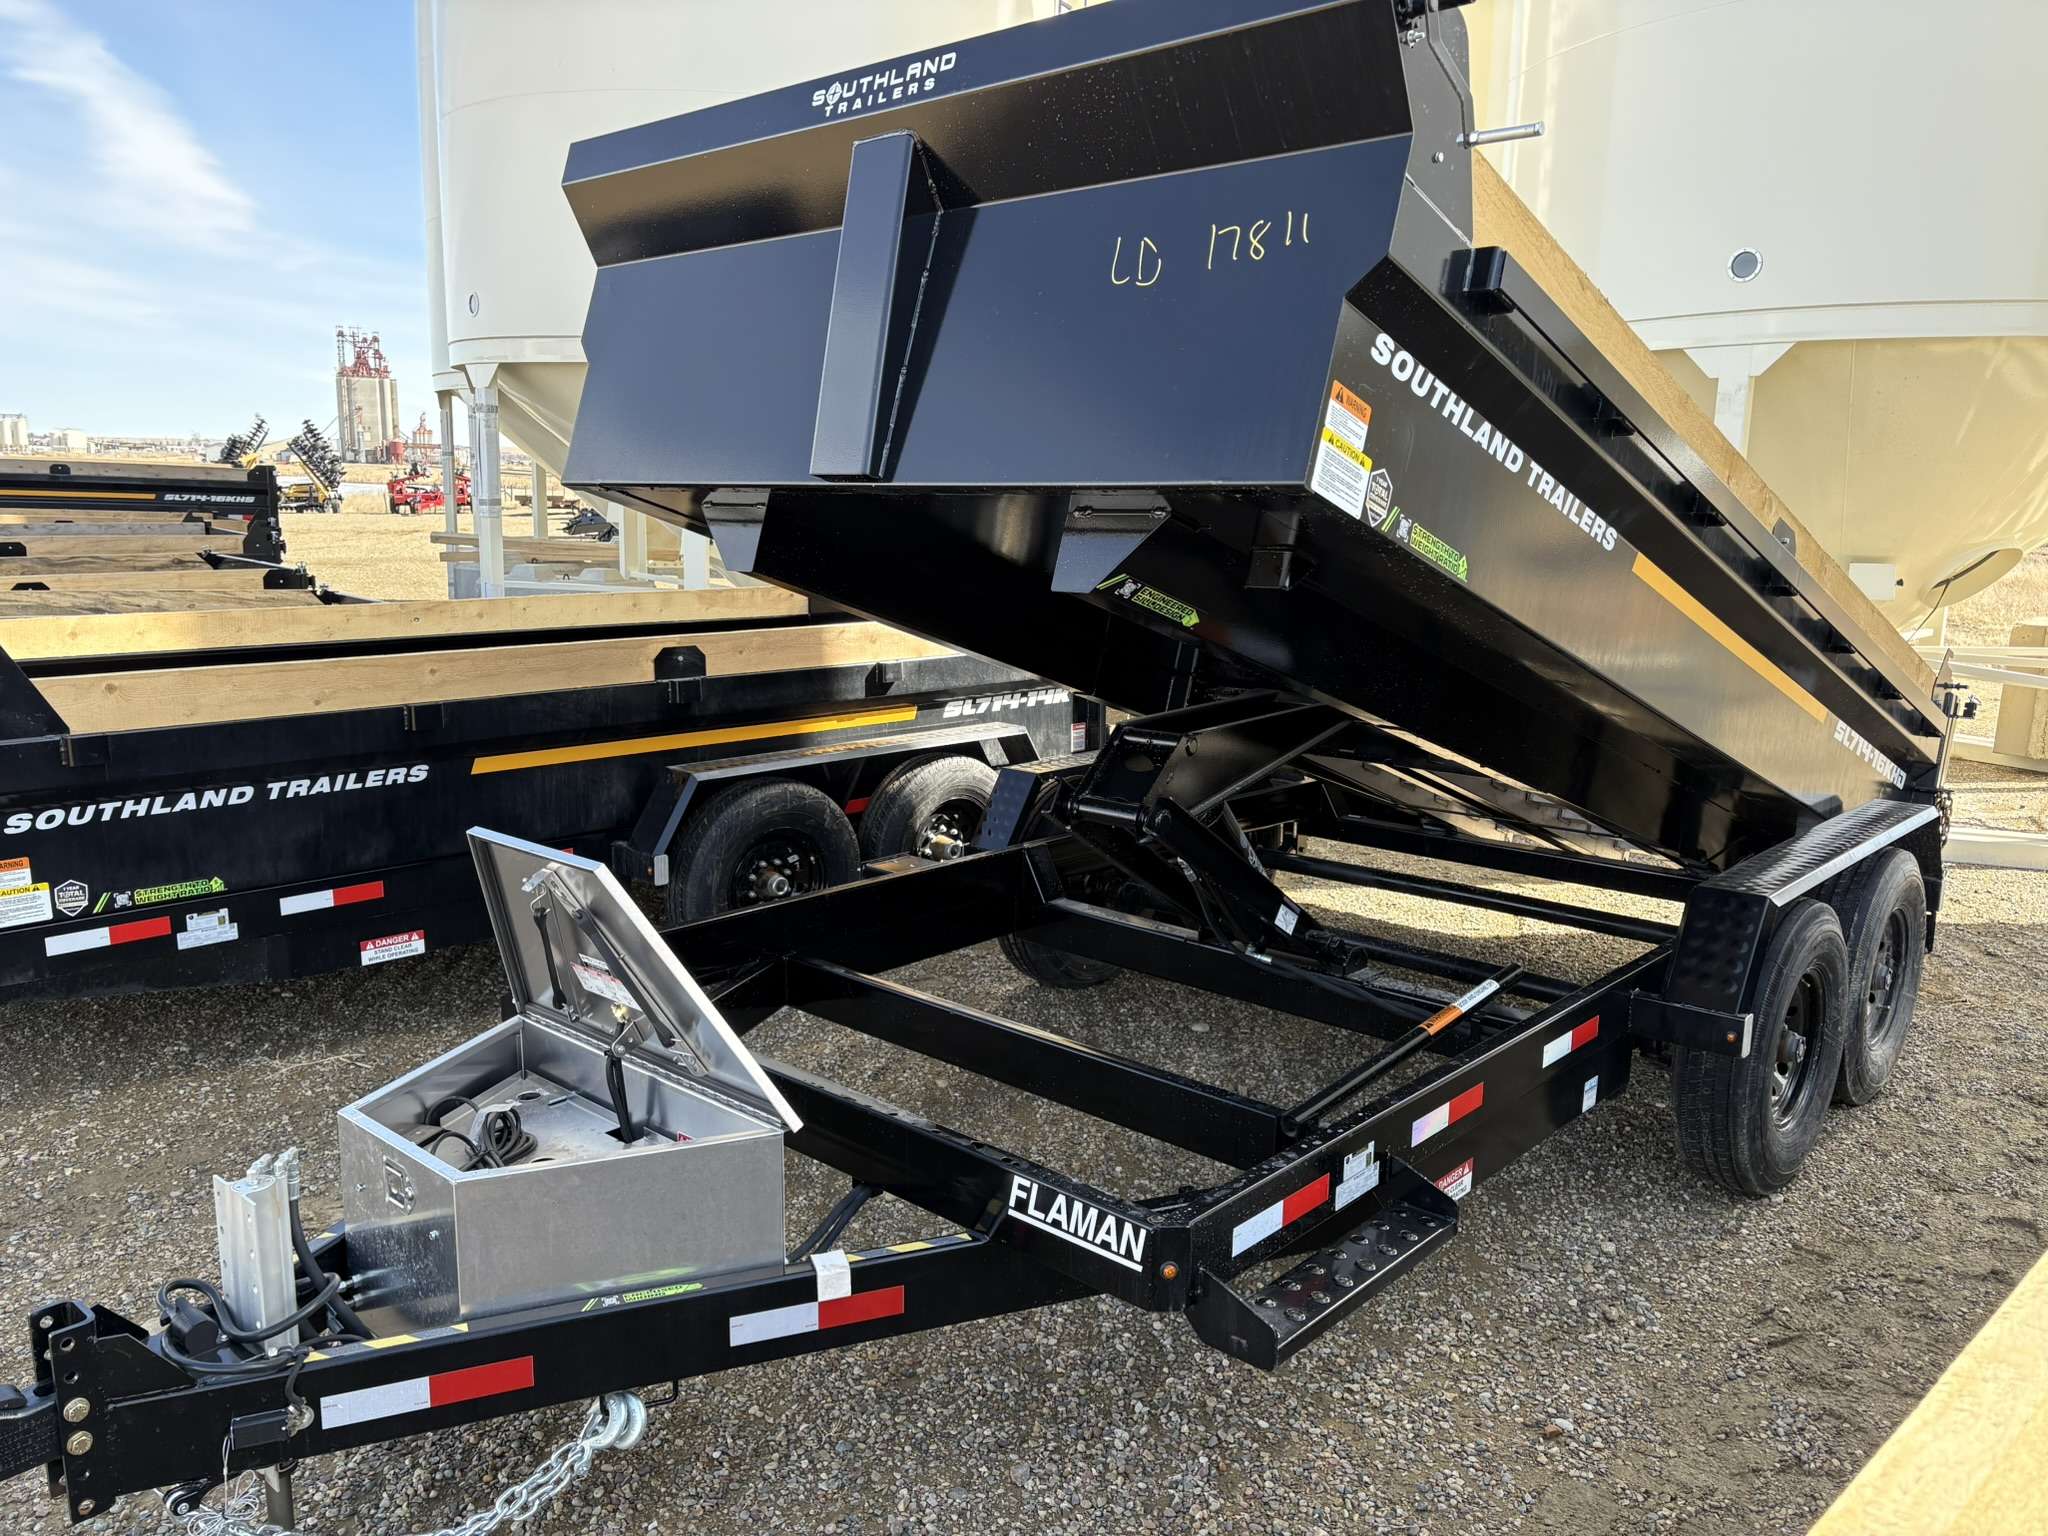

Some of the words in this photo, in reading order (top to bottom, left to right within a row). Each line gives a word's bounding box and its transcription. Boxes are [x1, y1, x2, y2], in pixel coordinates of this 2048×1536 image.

[811, 51, 957, 107] SOUTHLAND
[824, 77, 936, 117] TRAILERS
[1207, 210, 1309, 270] 17811
[1335, 438, 1361, 462] CAUTION
[1370, 332, 1524, 473] SOUTHLAND
[1527, 460, 1618, 551] TRAILERS
[1371, 482, 1389, 501] TOTAL
[1438, 551, 1459, 573] RATIO
[1140, 588, 1195, 616] ENGINEERED
[1154, 601, 1186, 621] DESIGN
[3, 786, 255, 835] SOUTHLAND
[266, 764, 430, 800] TRAILERS
[0, 860, 24, 869] ARNING
[0, 886, 30, 897] AUTION
[58, 890, 85, 898] TOTAL
[136, 892, 179, 904] WEIGHT
[180, 886, 210, 897] RATIO
[375, 934, 410, 948] DANGER
[393, 943, 412, 951] CLEAR
[387, 947, 419, 958] OPERATING
[1008, 1175, 1147, 1263] FLAMAN
